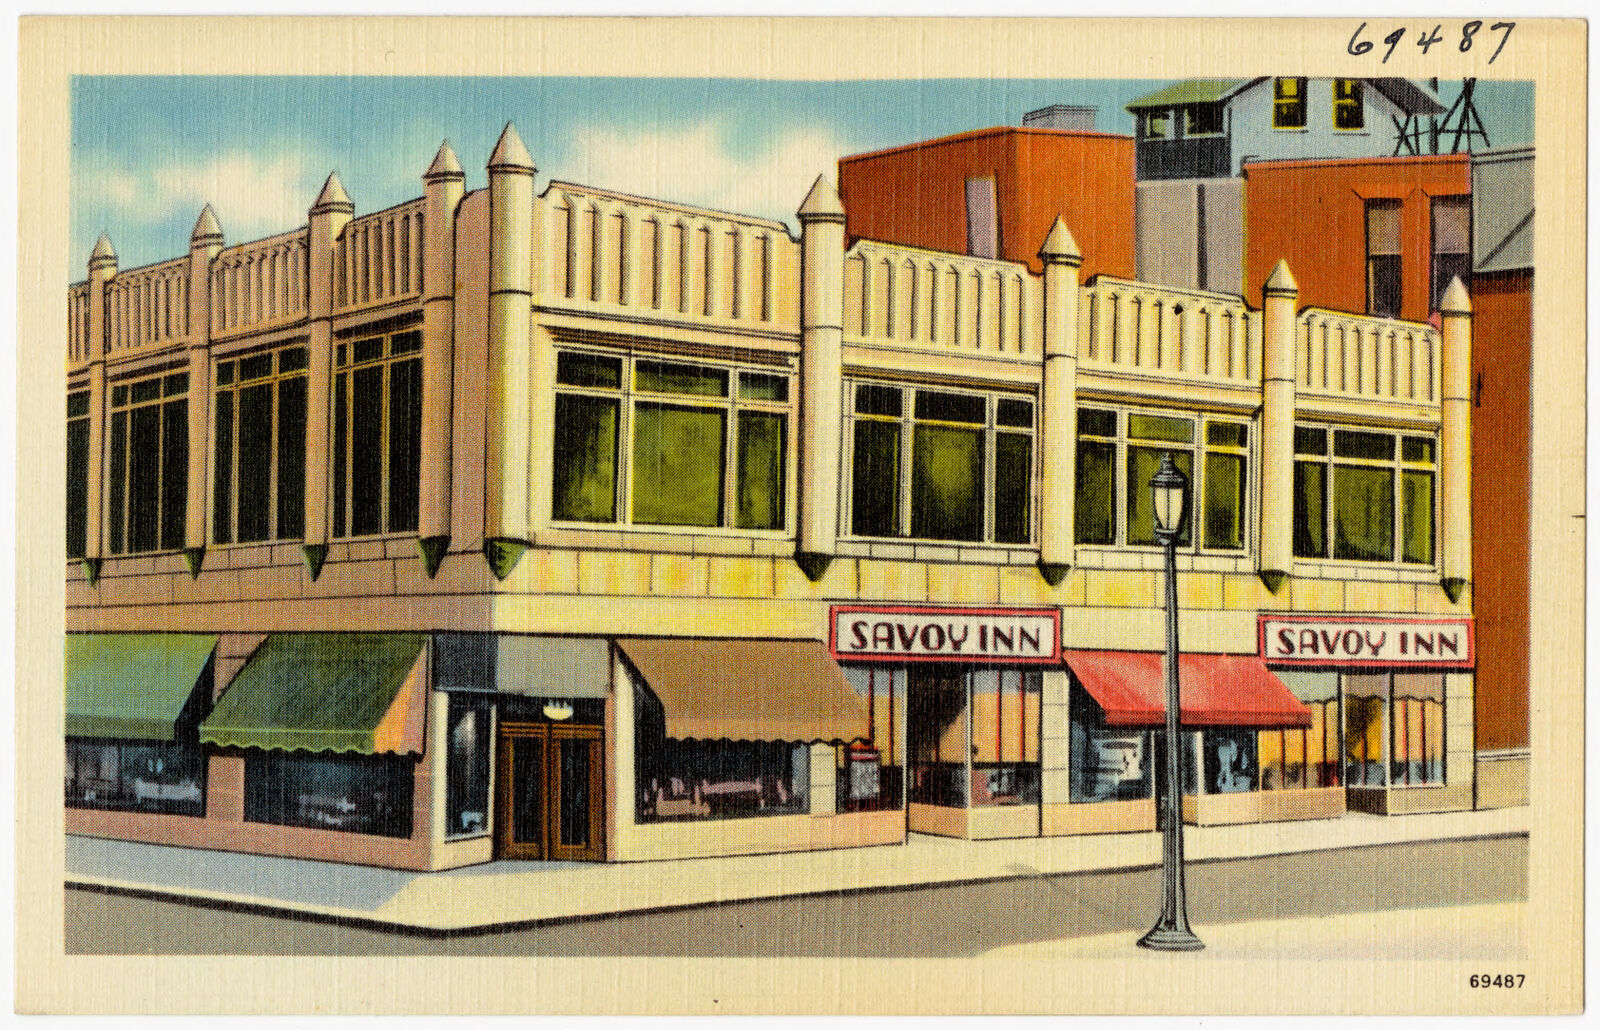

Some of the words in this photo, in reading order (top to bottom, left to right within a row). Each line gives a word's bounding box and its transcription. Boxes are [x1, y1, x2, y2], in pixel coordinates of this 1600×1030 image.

[1347, 20, 1516, 64] 69487
[850, 620, 969, 651] SAVOY
[978, 624, 1041, 652] INN
[1276, 627, 1387, 656] SAVOY
[1400, 630, 1459, 656] INN
[1469, 974, 1526, 988] 69487
